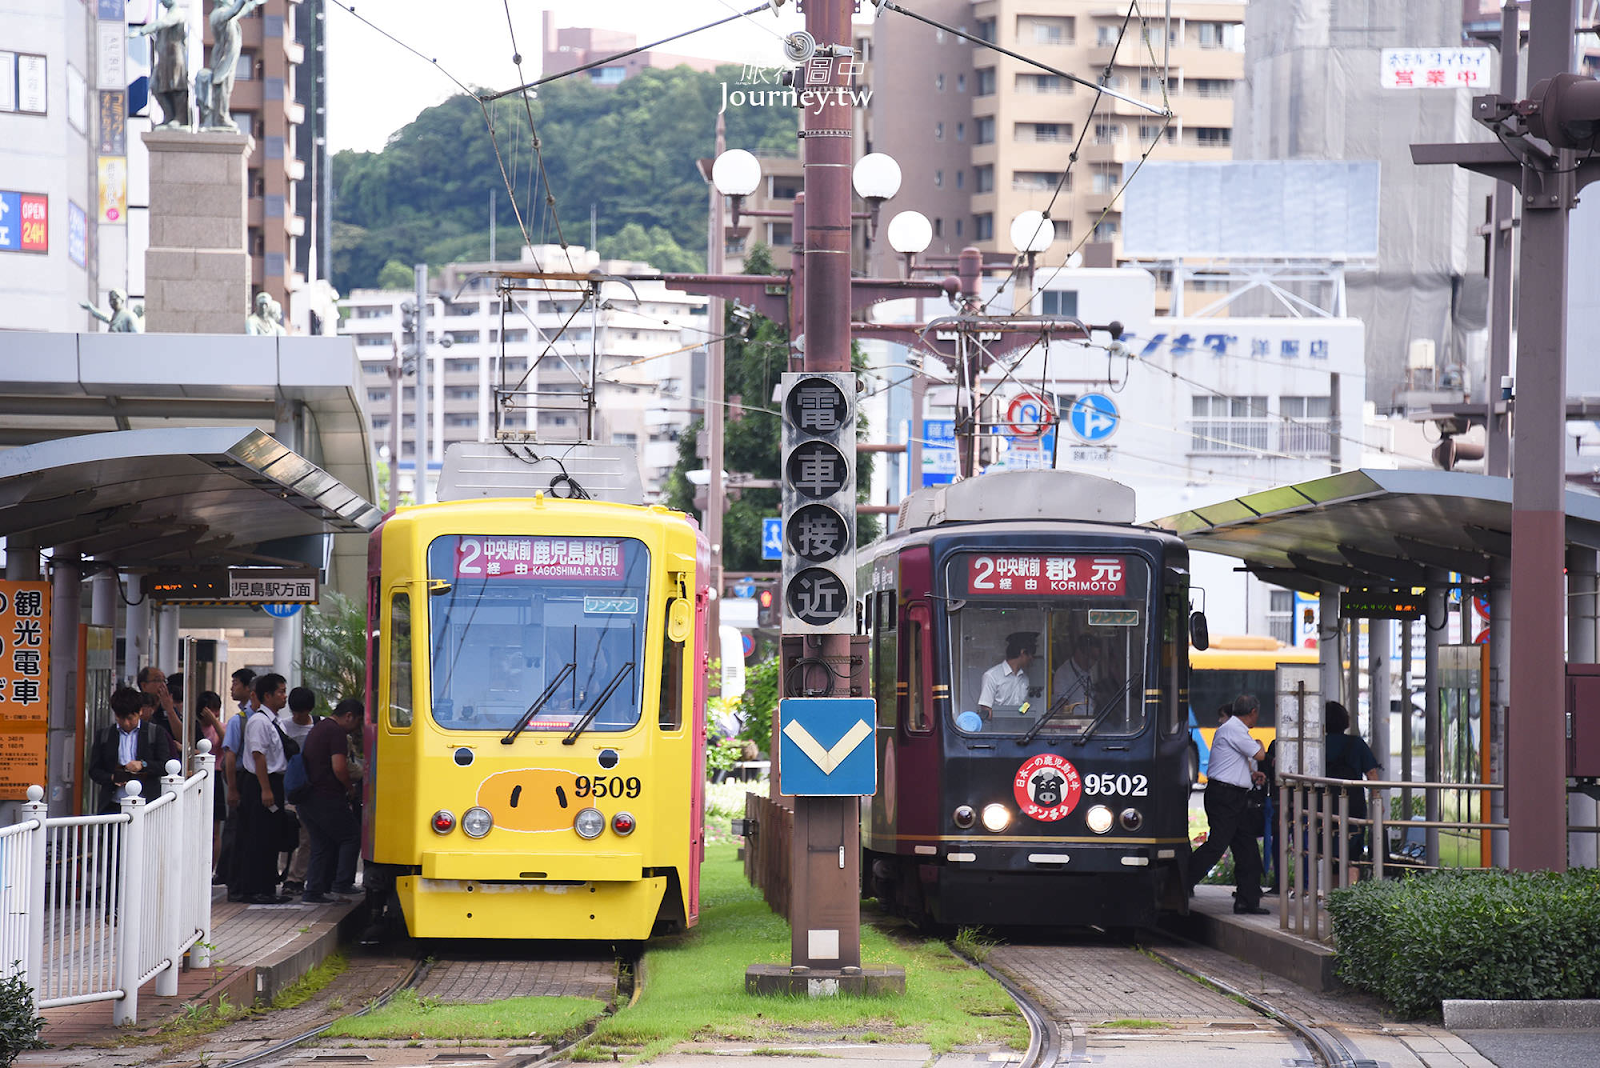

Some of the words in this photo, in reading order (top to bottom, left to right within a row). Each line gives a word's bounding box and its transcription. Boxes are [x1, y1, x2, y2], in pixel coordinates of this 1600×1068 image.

[1395, 70, 1477, 87] 営業中
[22, 201, 46, 220] OPEN
[23, 221, 45, 243] 24H
[795, 386, 841, 619] 電車接近
[458, 538, 482, 574] 2
[484, 539, 532, 561] 中央駅前
[533, 540, 620, 566] 鹿児島駅前
[486, 562, 529, 575] 経由
[973, 557, 995, 590] 2
[996, 557, 1041, 577] 中央駅前
[1045, 557, 1122, 582] 郡元
[231, 582, 311, 597] 児島駅方面
[999, 578, 1038, 590] 経由
[1050, 581, 1117, 592] KORIMOTO
[586, 598, 636, 611] ワンマン
[1090, 611, 1137, 624] ワンマン
[11, 588, 42, 706] 観光電車
[574, 775, 641, 799] 9509
[1084, 773, 1148, 797] 9502
